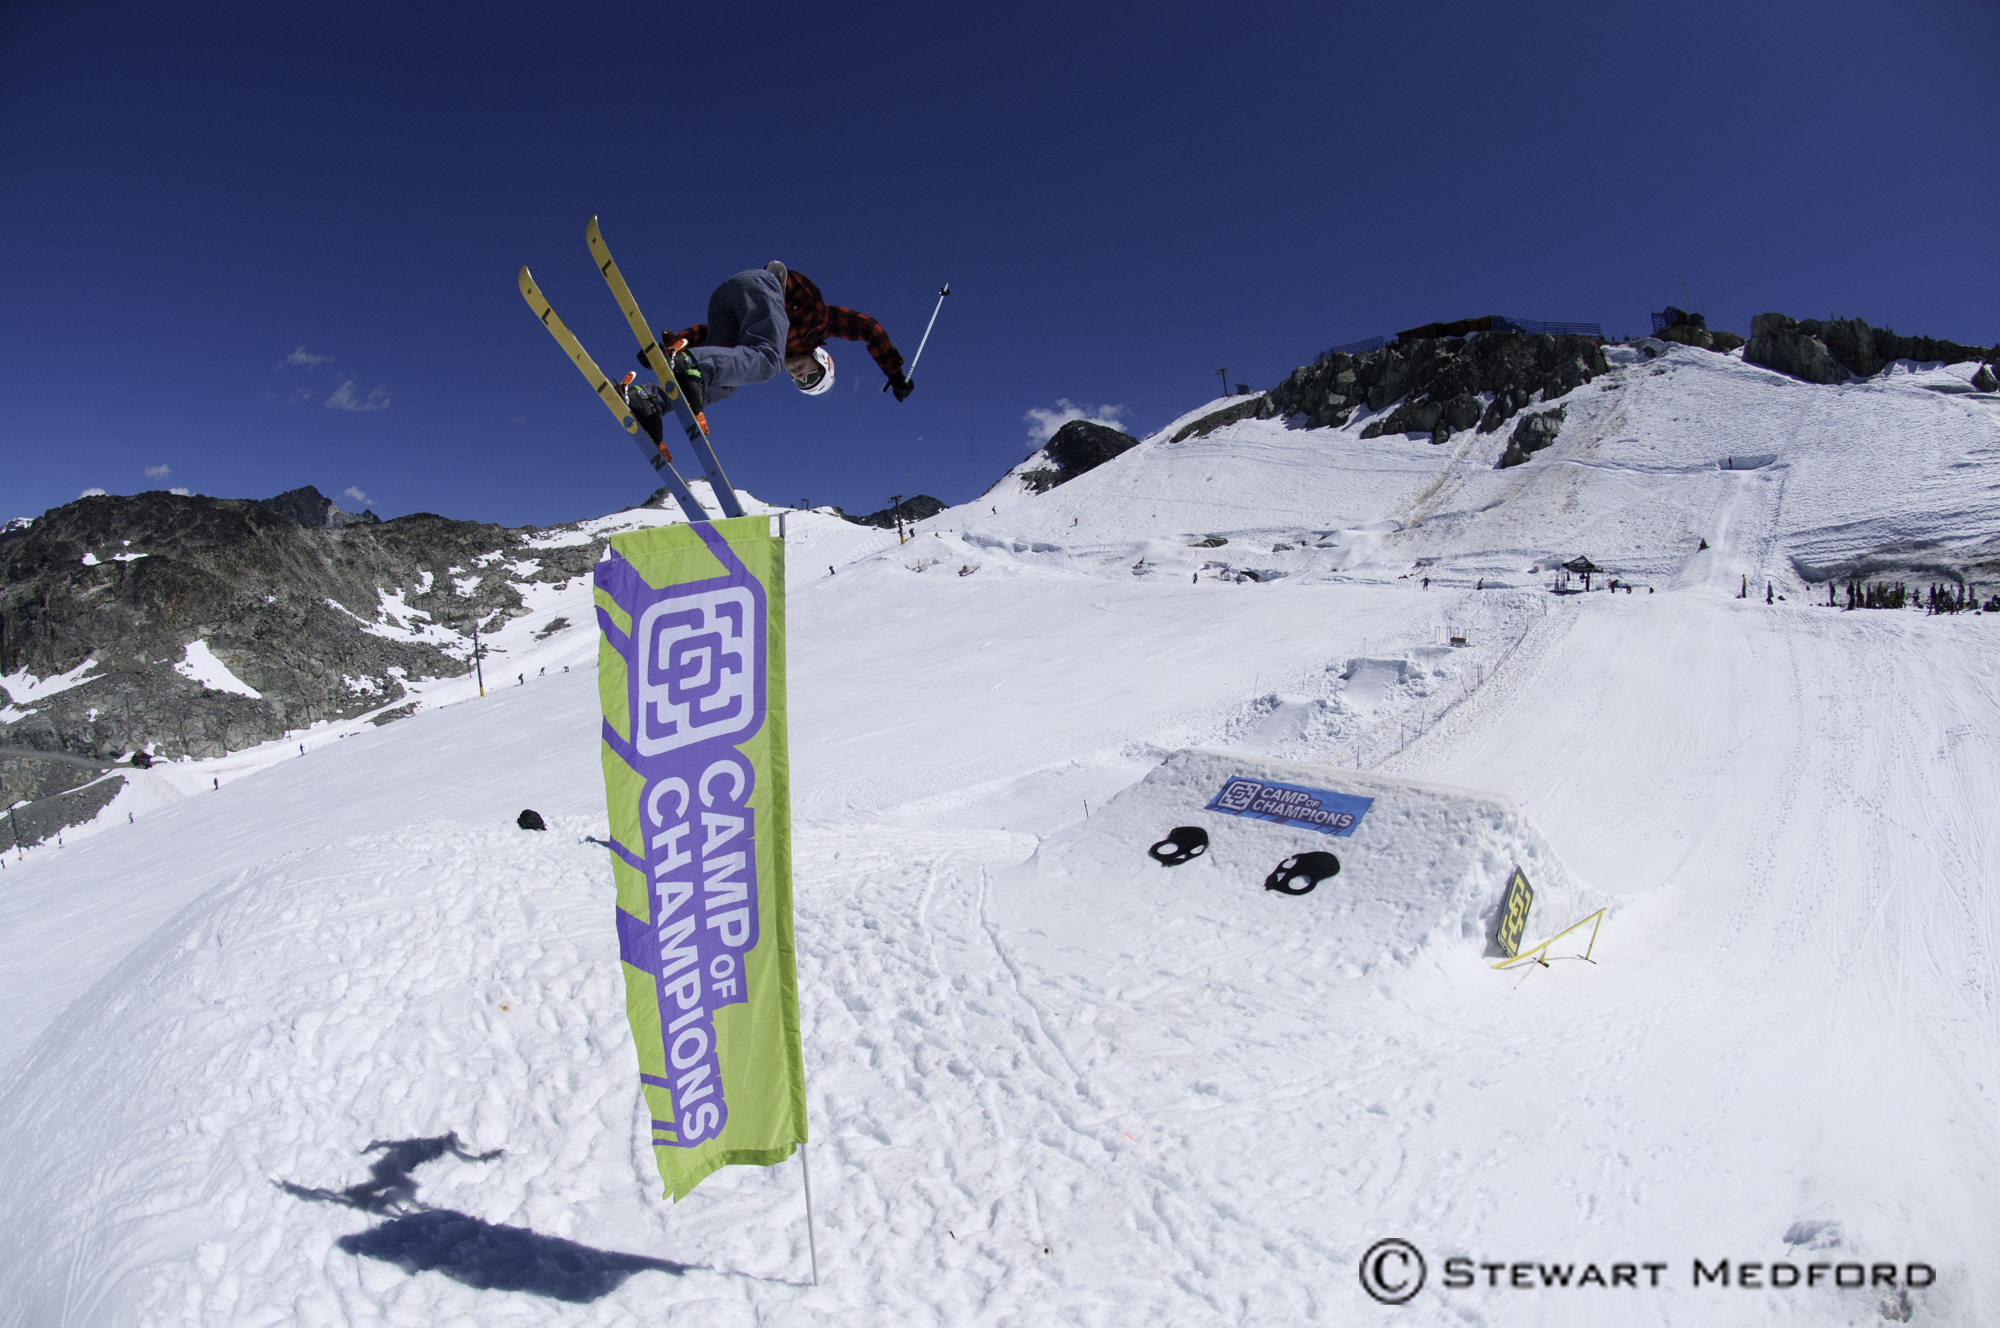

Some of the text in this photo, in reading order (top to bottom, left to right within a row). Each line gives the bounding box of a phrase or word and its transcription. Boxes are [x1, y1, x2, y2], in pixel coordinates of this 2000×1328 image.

[1252, 799, 1353, 827] CHAMPIONS
[1260, 787, 1320, 808] CAMP OF
[698, 759, 750, 998] CAMP OF
[647, 776, 720, 1140] CHAMPIONS
